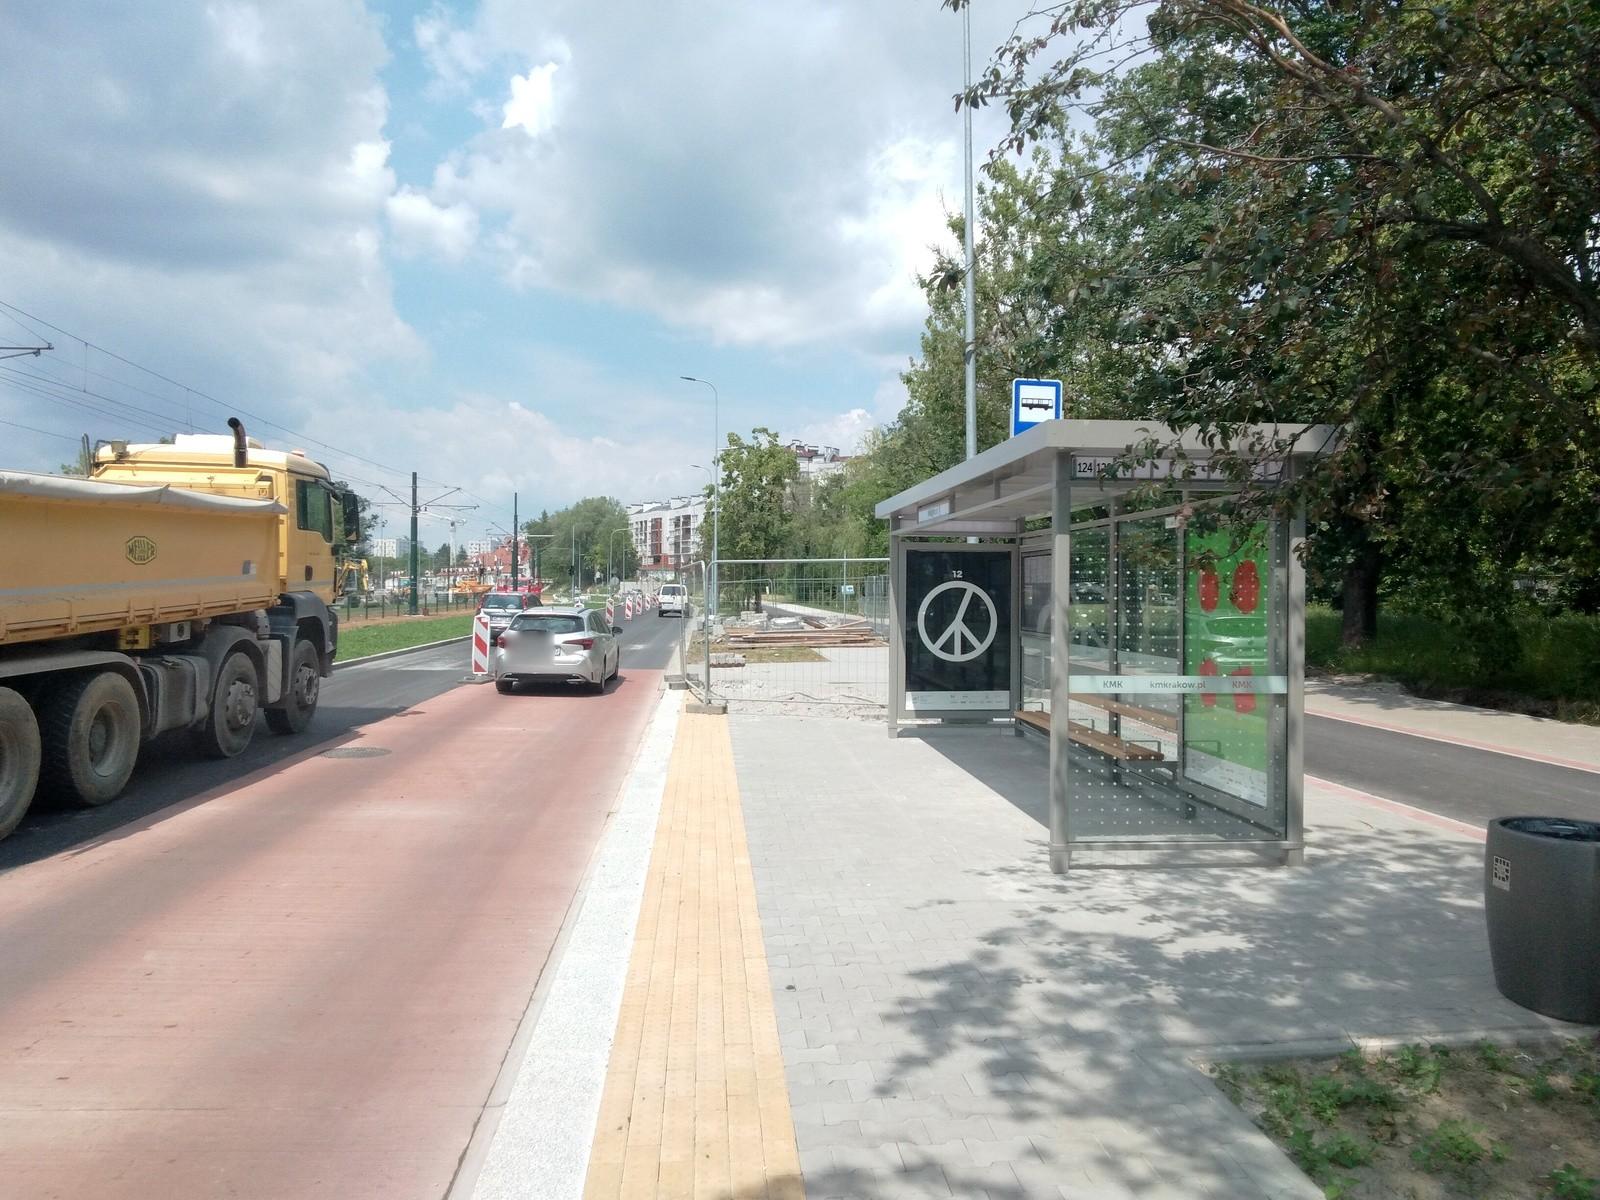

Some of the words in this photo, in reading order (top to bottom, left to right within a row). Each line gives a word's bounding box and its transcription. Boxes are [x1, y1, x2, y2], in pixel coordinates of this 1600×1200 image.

[1077, 462, 1093, 473] 124
[952, 570, 963, 578] 12
[1103, 680, 1123, 688] KMK
[1150, 680, 1206, 690] kmkrakow.pl
